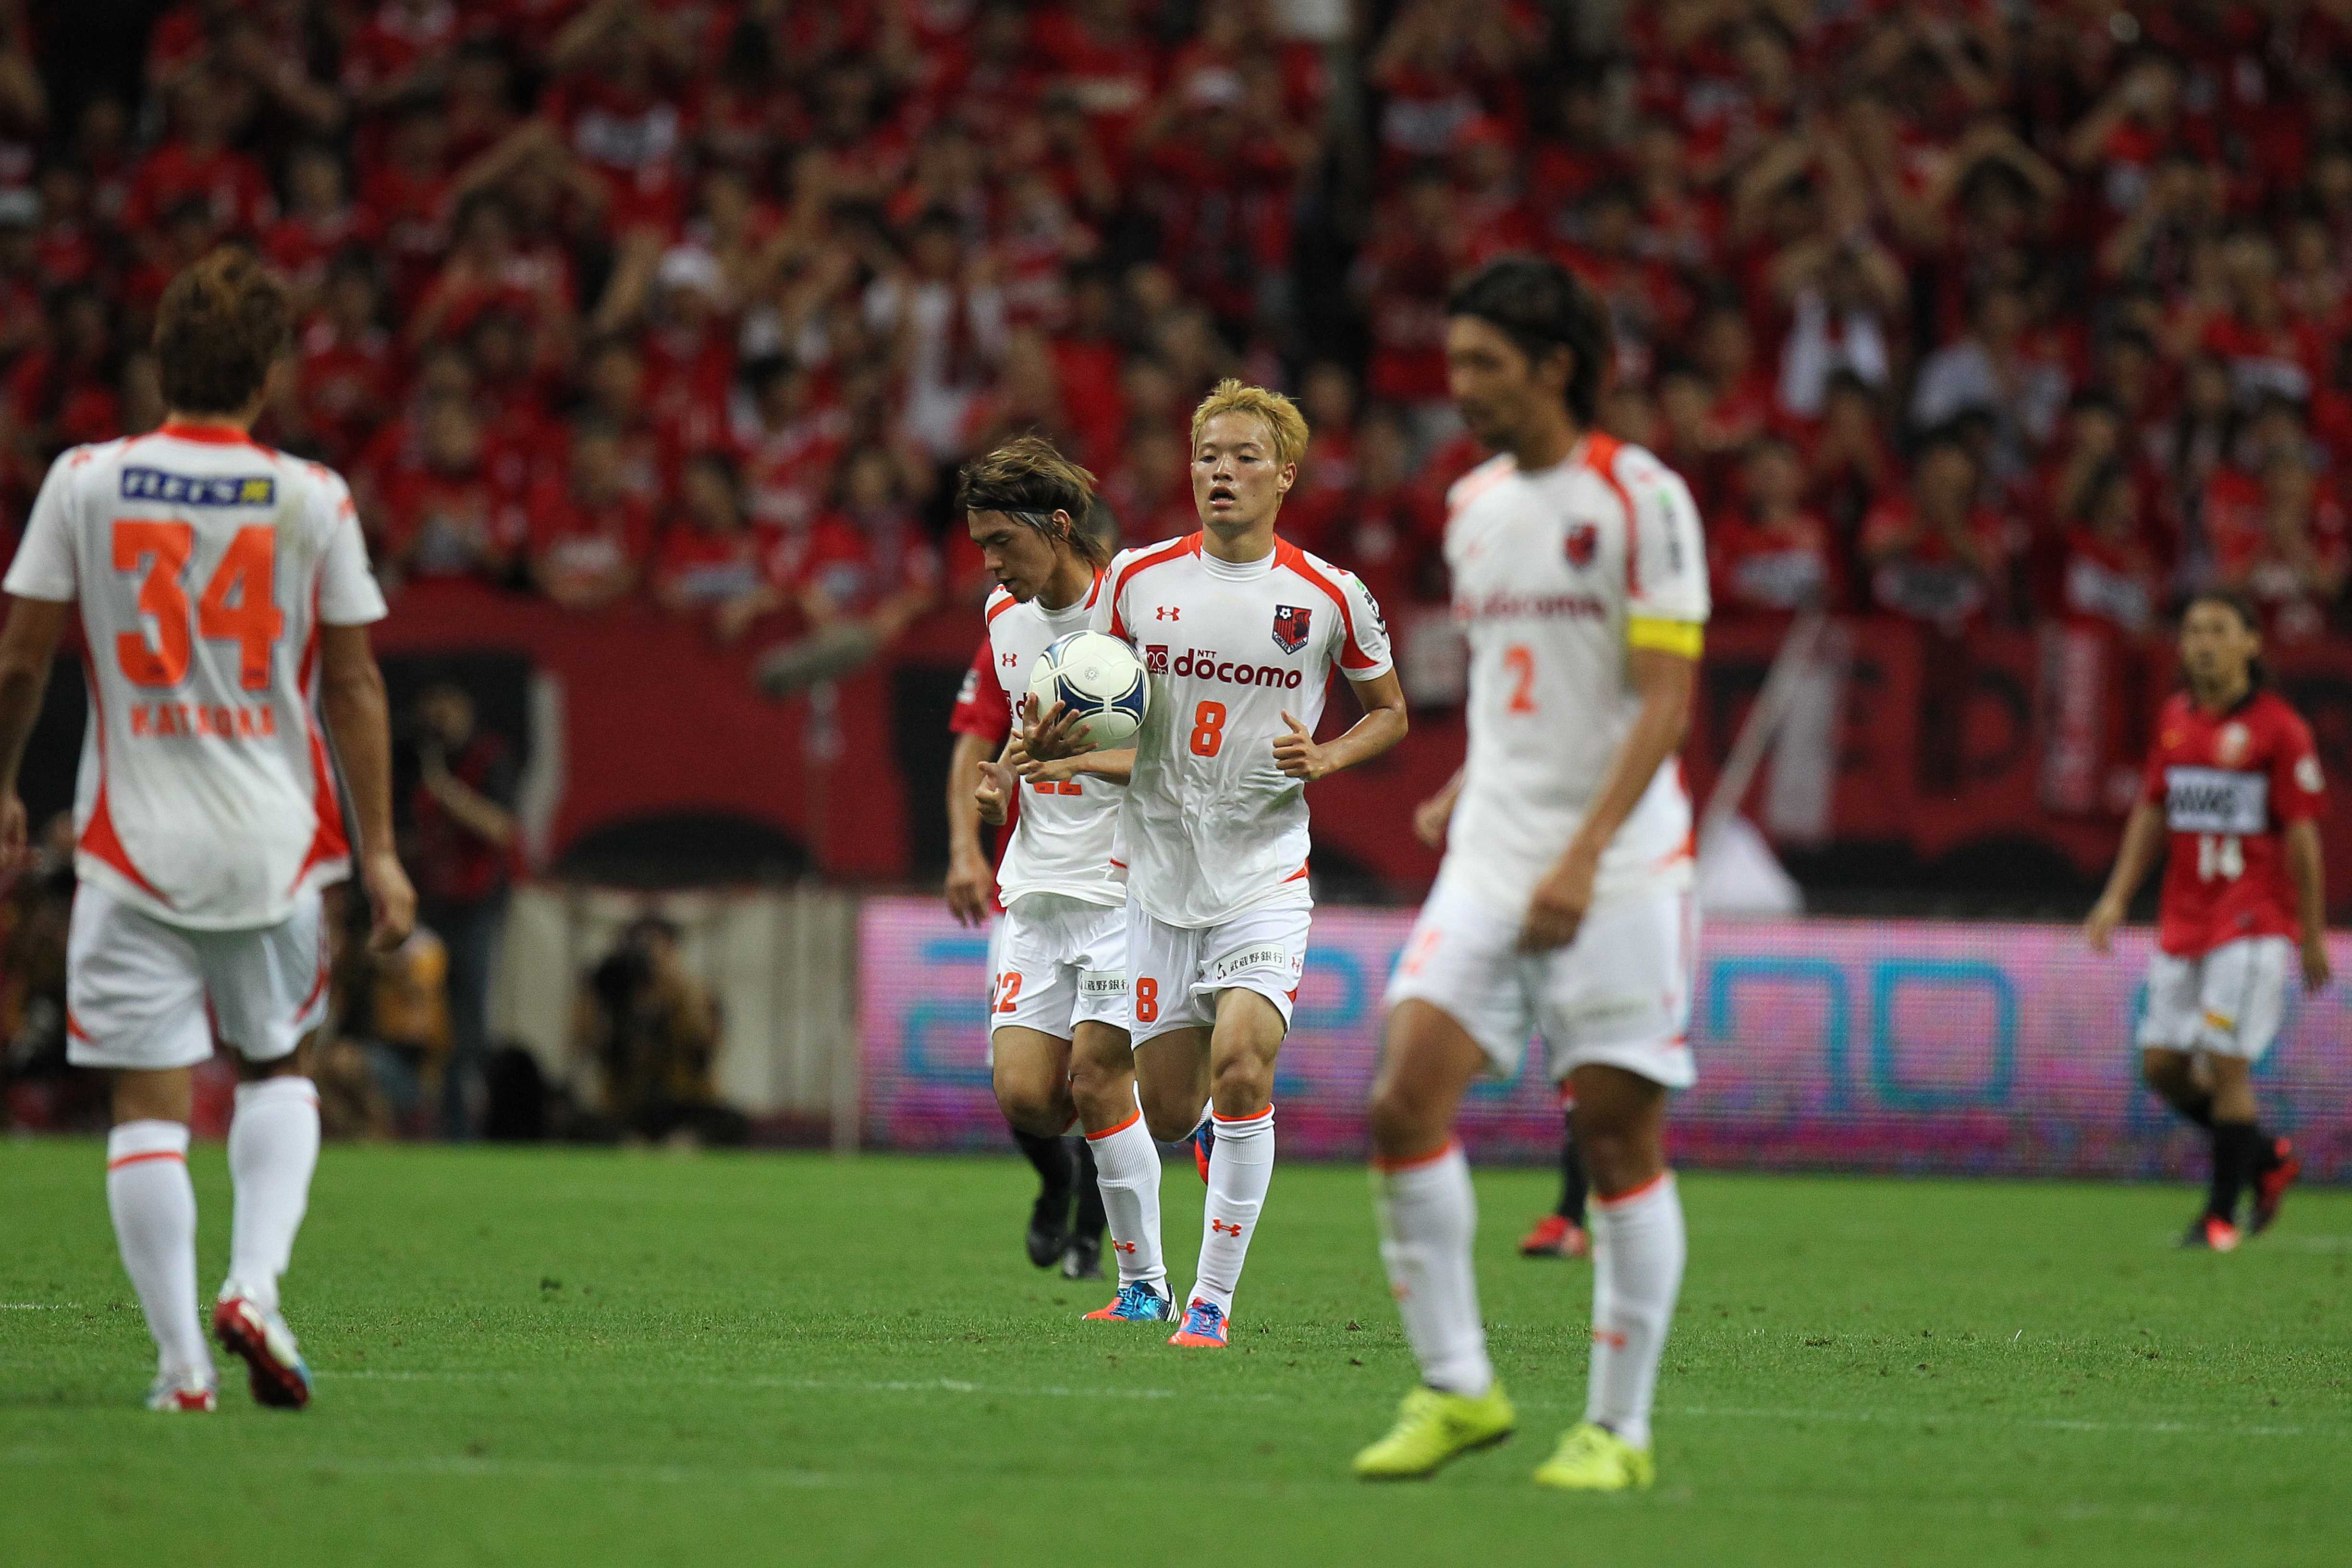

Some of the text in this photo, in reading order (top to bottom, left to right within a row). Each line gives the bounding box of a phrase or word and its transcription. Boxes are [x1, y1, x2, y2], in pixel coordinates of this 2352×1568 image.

[113, 519, 283, 692] 34
[1148, 651, 1168, 670] 20
[1174, 649, 1301, 689] docomo
[1198, 650, 1216, 658] NTT
[1503, 647, 1540, 712] 2
[1190, 700, 1226, 757] 8
[2198, 834, 2244, 882] 14
[1230, 951, 1283, 972] 武蔵野銀行
[1136, 978, 1158, 1022] 8
